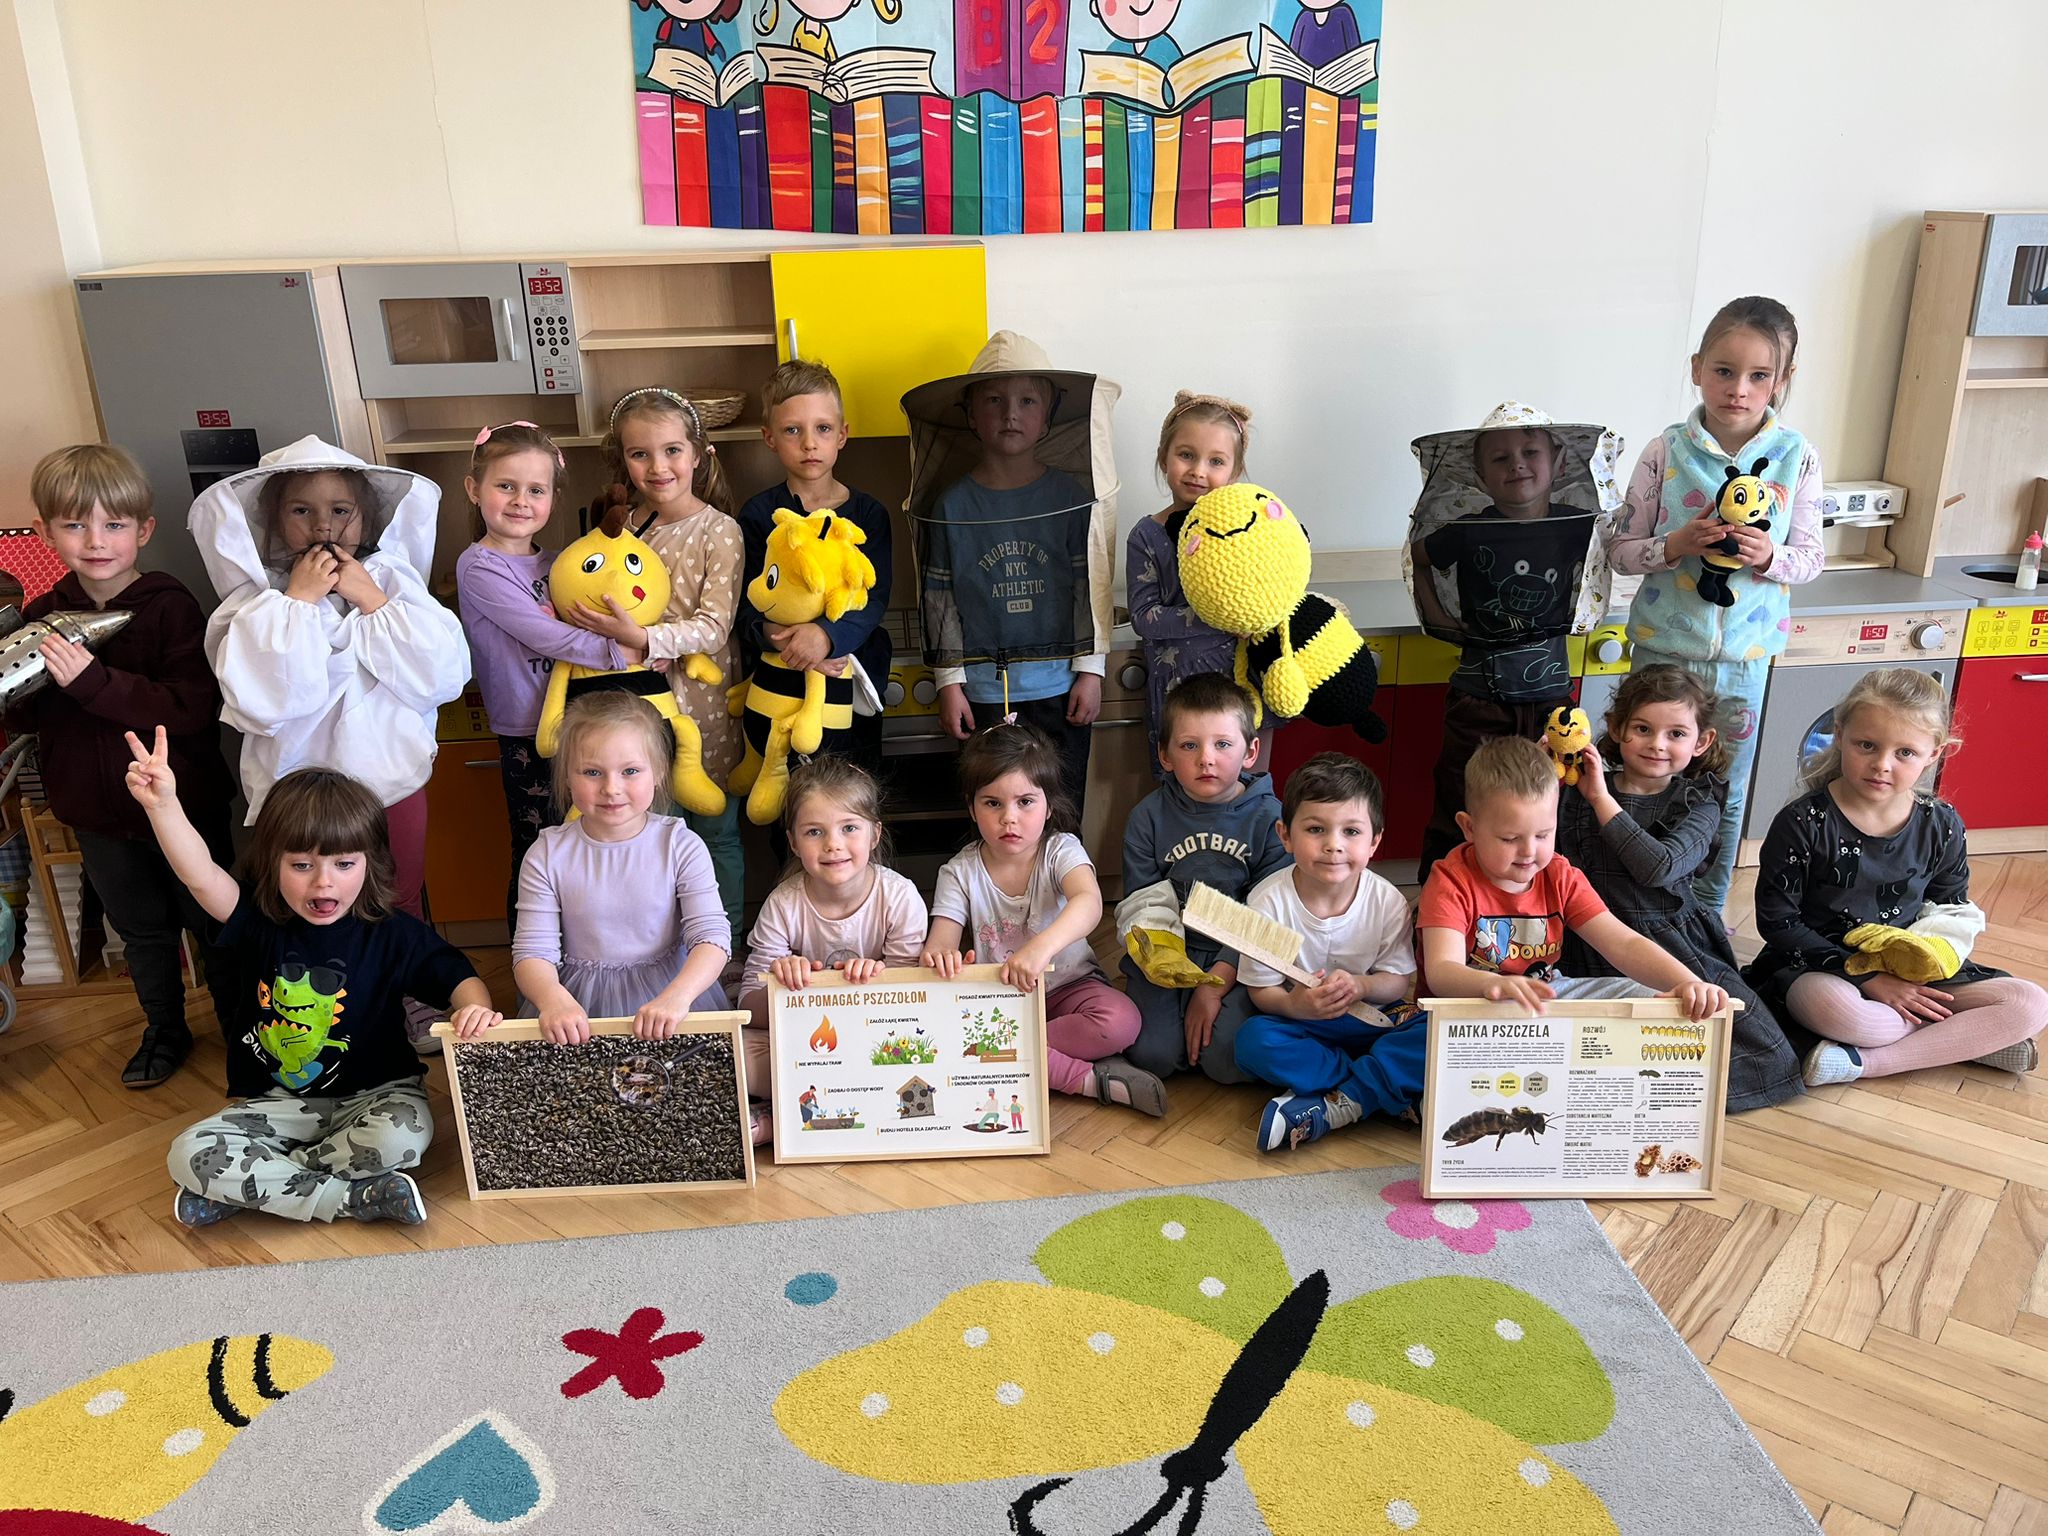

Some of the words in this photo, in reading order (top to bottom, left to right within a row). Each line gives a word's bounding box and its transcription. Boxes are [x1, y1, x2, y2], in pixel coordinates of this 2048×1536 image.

[1026, 0, 1058, 64] 2
[530, 280, 561, 293] 13:52
[200, 412, 229, 425] 13:52
[978, 541, 1036, 572] PROPERTY
[1036, 549, 1049, 565] OF
[1005, 561, 1028, 577] NYC
[991, 580, 1045, 598] ATHLETIC
[1009, 602, 1030, 611] CLUB
[1865, 627, 1885, 638] 1:50
[786, 995, 805, 1008] JAK
[808, 991, 860, 1007] POMAGAĆ
[863, 990, 927, 1005] PSZCZOŁOM
[1448, 1025, 1488, 1038] MATKA
[1491, 1024, 1550, 1038] PSZCZELA
[1582, 1025, 1606, 1034] ROZWÓJ
